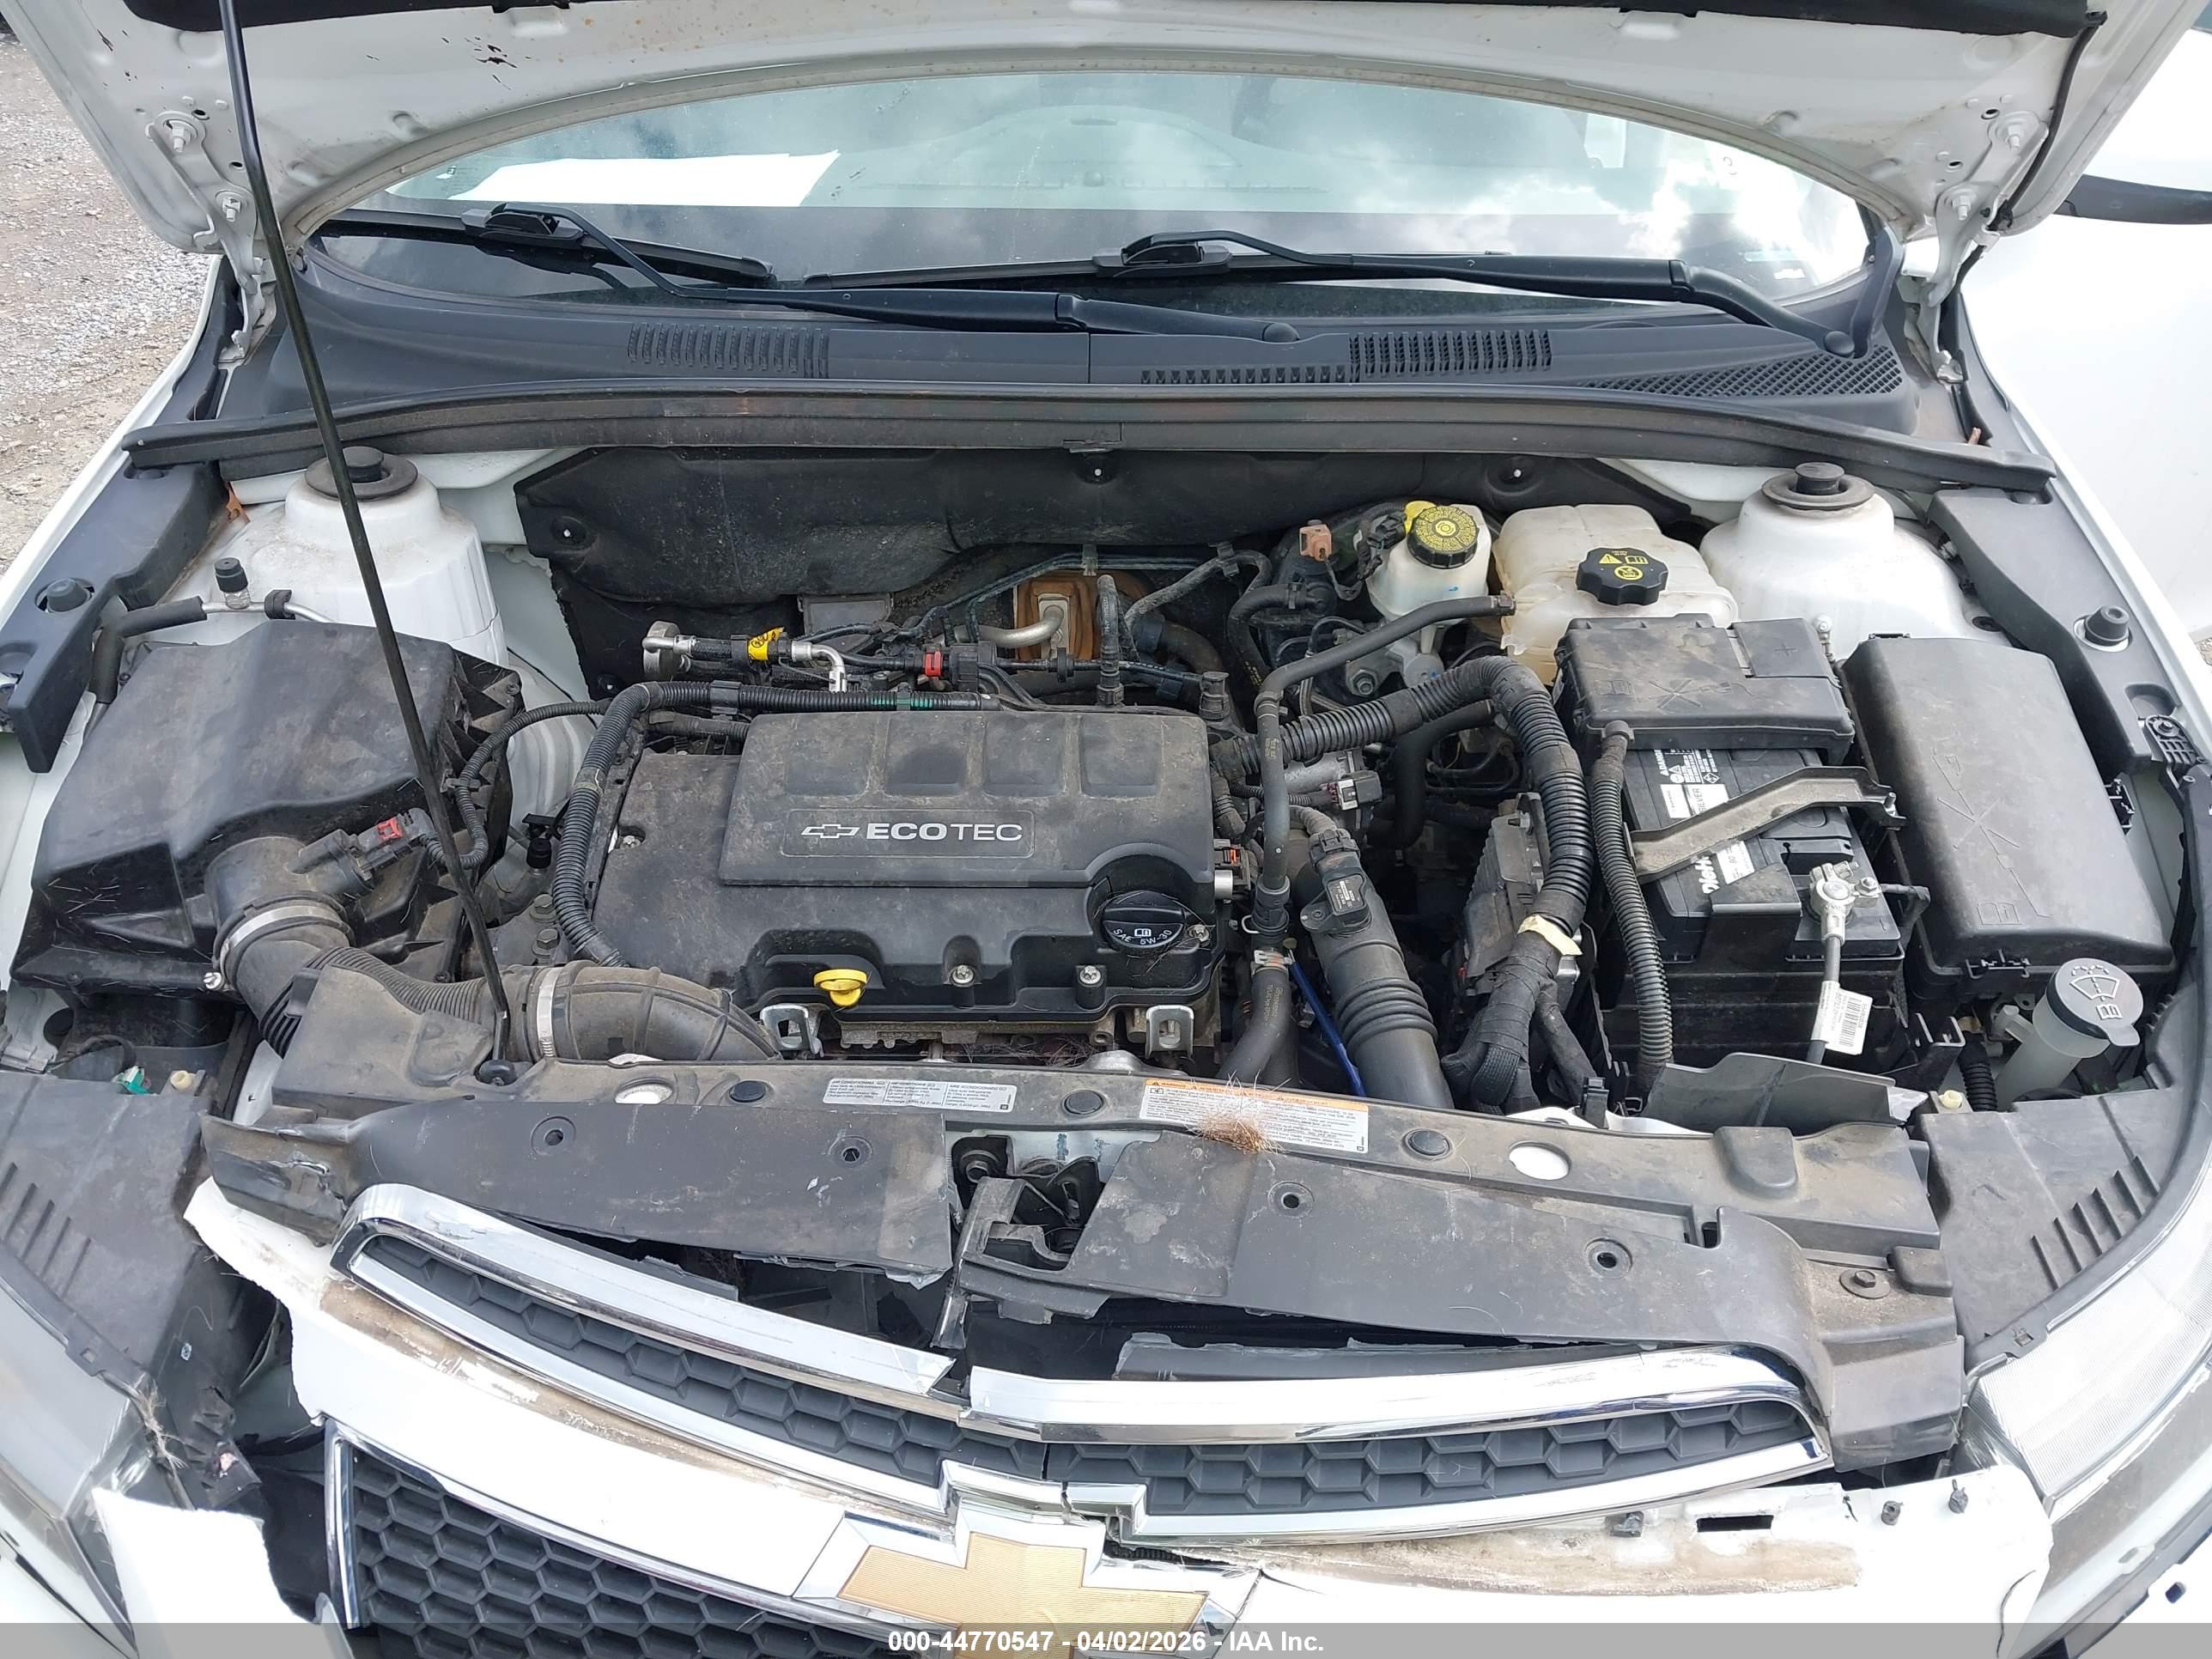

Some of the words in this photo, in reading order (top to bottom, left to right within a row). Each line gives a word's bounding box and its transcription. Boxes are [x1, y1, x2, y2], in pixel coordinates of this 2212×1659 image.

[1654, 749, 1668, 770] DANGE
[866, 823, 1023, 842] ECOTEC
[1694, 855, 1721, 894] DieH
[1114, 929, 1132, 943] SAE
[1140, 930, 1173, 945] 5W-30
